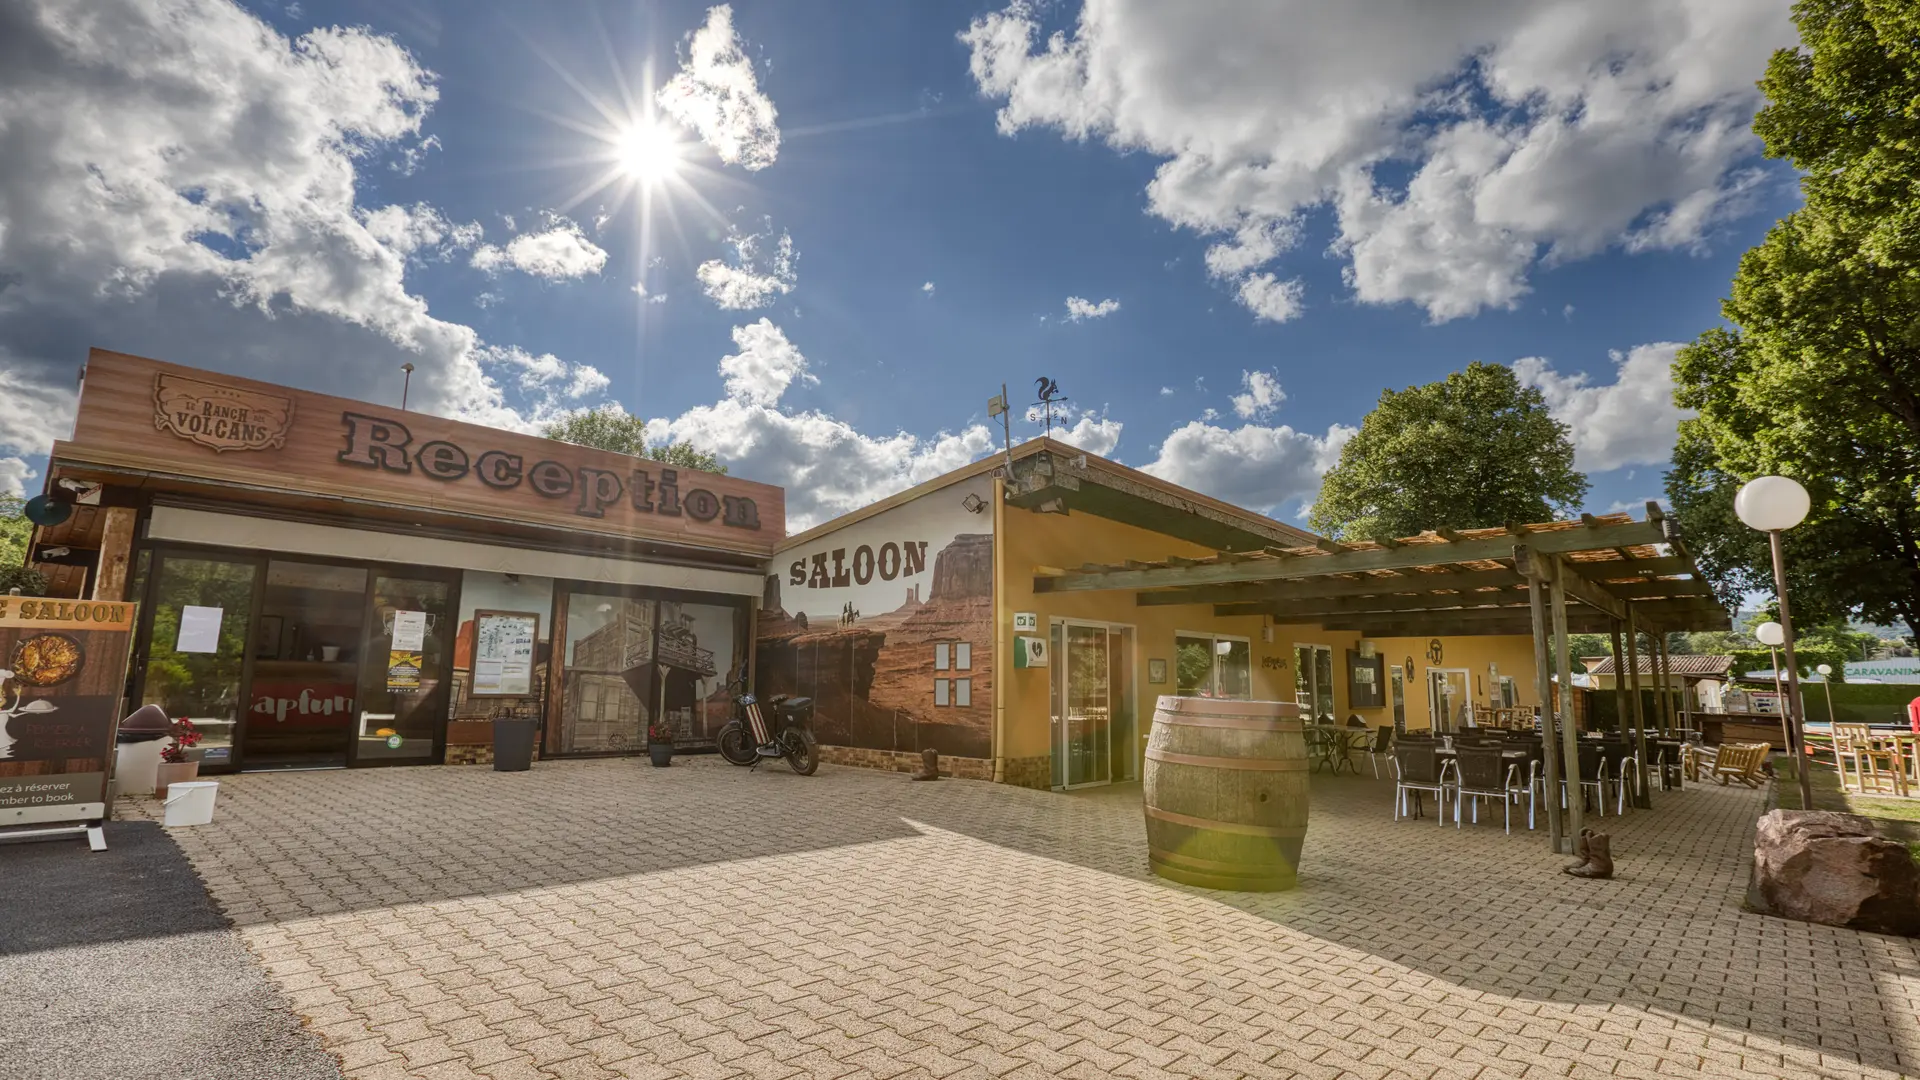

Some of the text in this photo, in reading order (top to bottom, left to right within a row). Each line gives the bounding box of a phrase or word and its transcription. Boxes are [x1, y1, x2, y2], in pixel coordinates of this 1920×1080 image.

[202, 401, 249, 423] RANCH
[176, 411, 268, 441] VOLCANS
[336, 411, 763, 530] Reception
[789, 541, 929, 589] SALOON
[19, 600, 127, 623] SALOON
[249, 688, 354, 722] apfun
[25, 782, 70, 792] réserver
[31, 795, 43, 803] to
[46, 792, 74, 802] book
